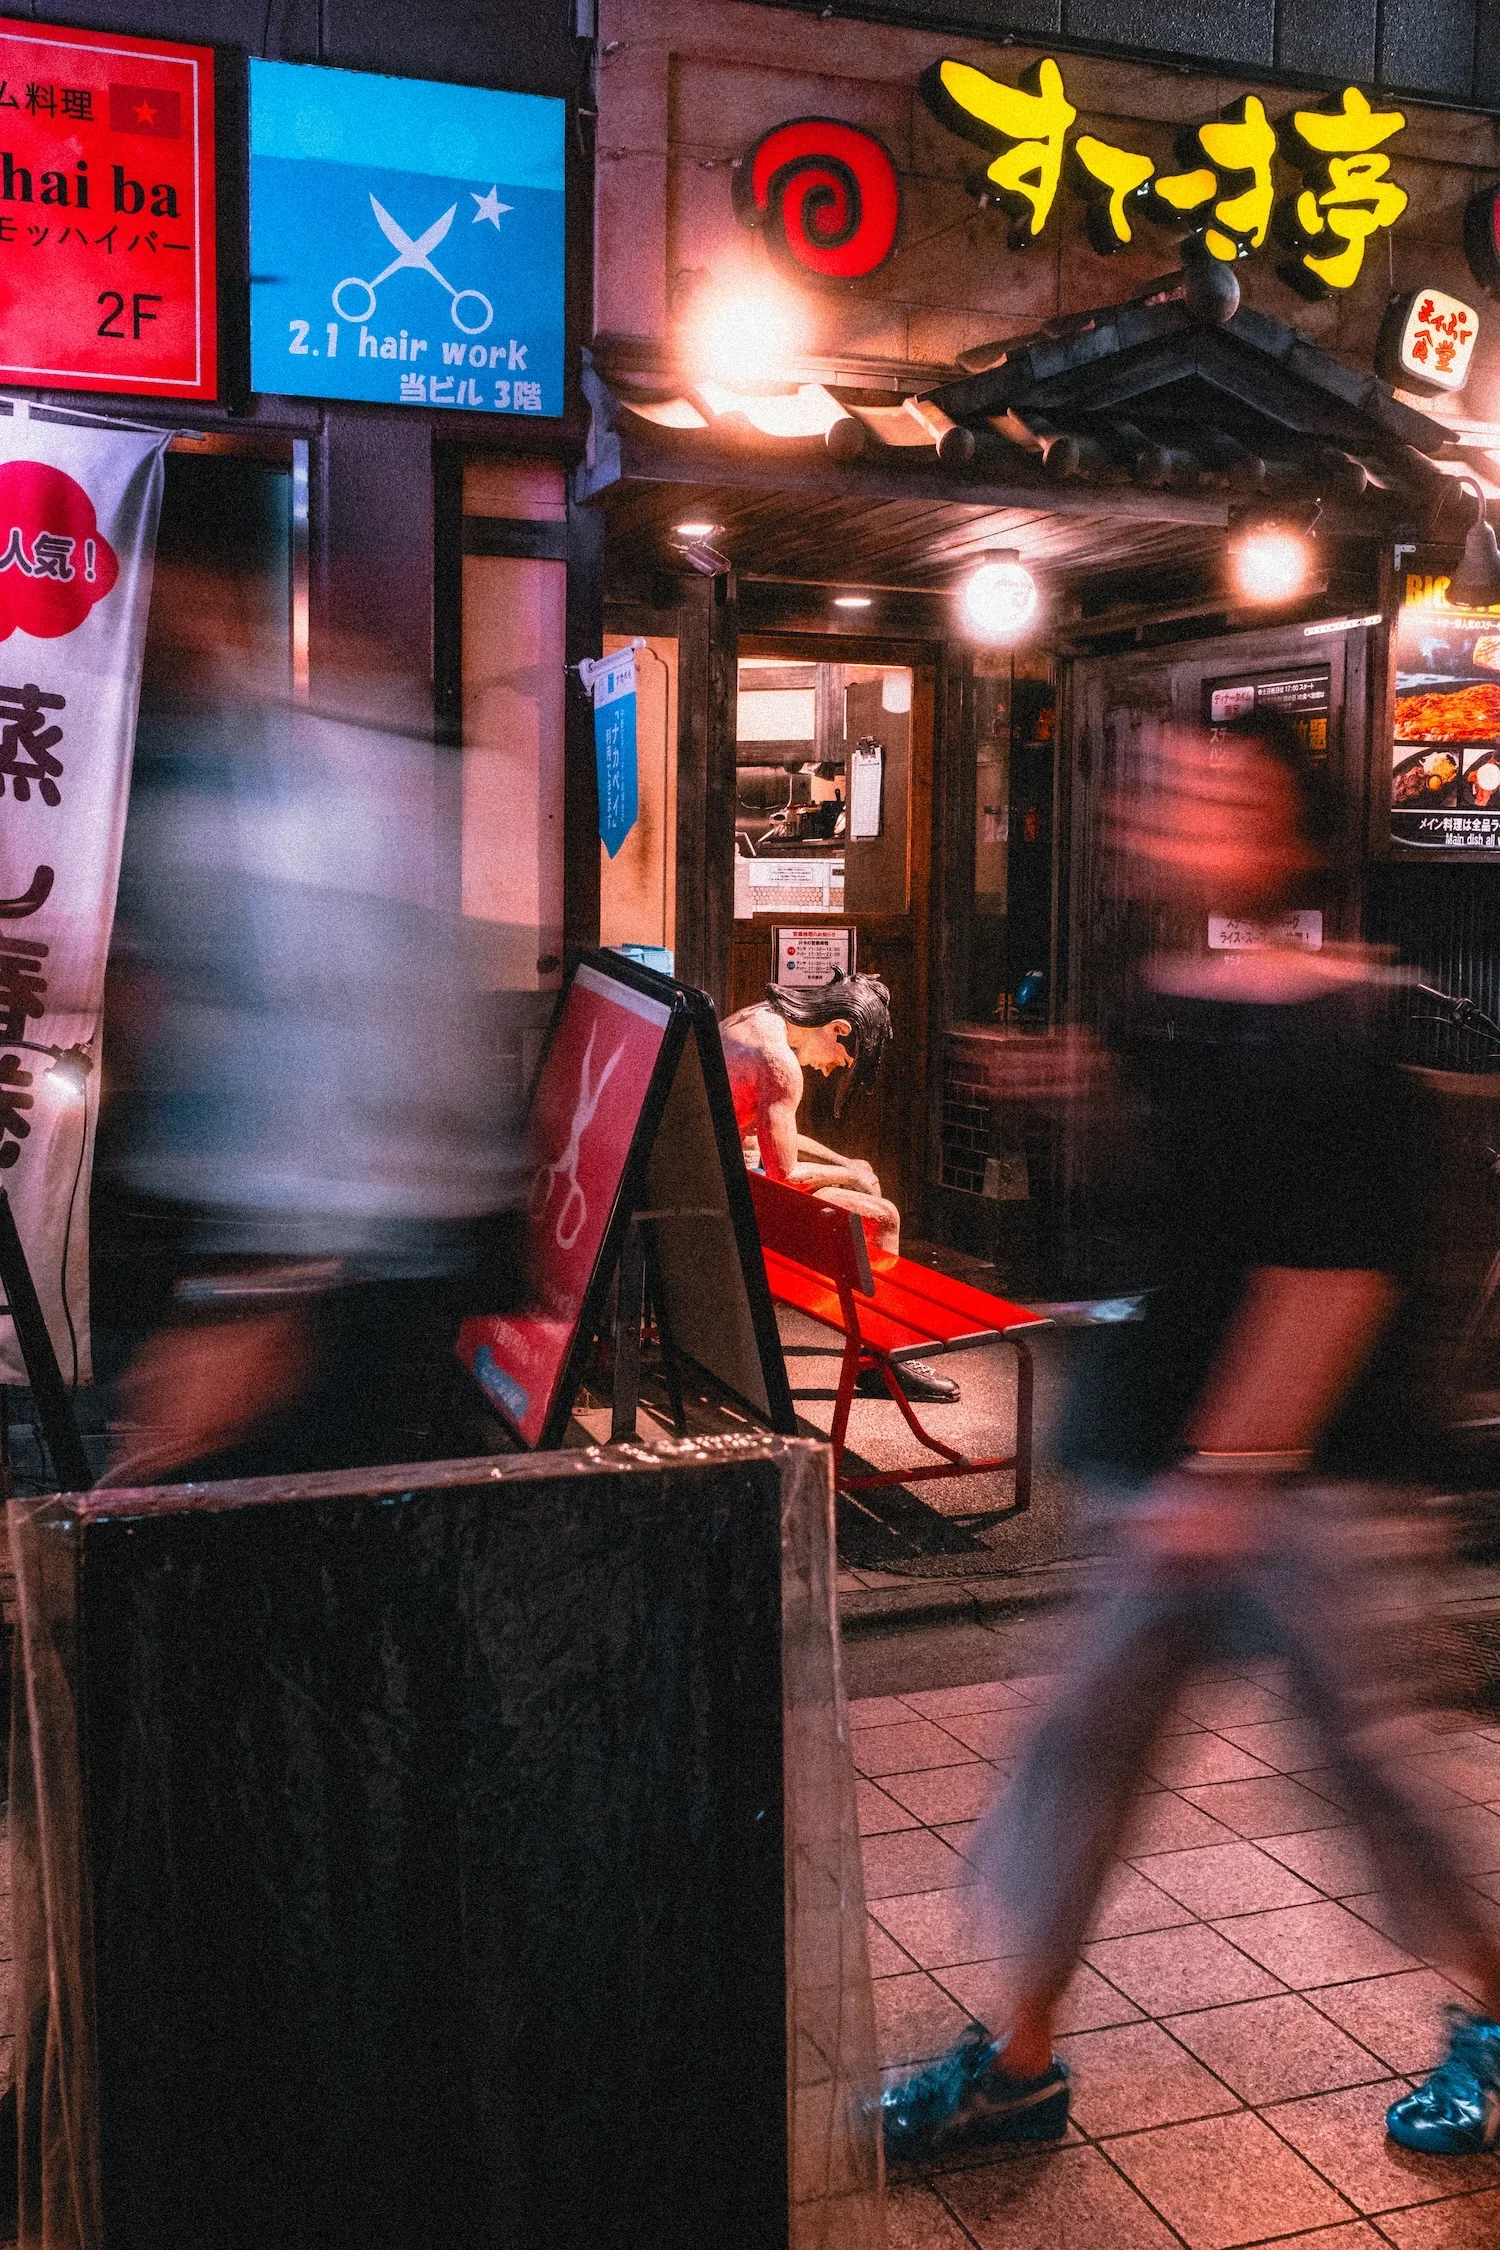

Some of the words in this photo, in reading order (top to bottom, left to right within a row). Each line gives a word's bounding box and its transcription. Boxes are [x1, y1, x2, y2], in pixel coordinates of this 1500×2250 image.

[111, 164, 181, 218] ba
[940, 58, 1408, 288] すてーき亭
[97, 291, 163, 340] 2F
[289, 320, 339, 358] 2.1
[358, 325, 427, 361] hair
[442, 339, 529, 371] work
[400, 372, 484, 406] 当ビル
[494, 380, 543, 411] 3階
[1285, 684, 1299, 692] 17:00
[1419, 816, 1500, 832] メイン料理は全品ラ
[1445, 833, 1464, 846] Main
[1467, 834, 1483, 846] dish
[1486, 834, 1496, 847] all
